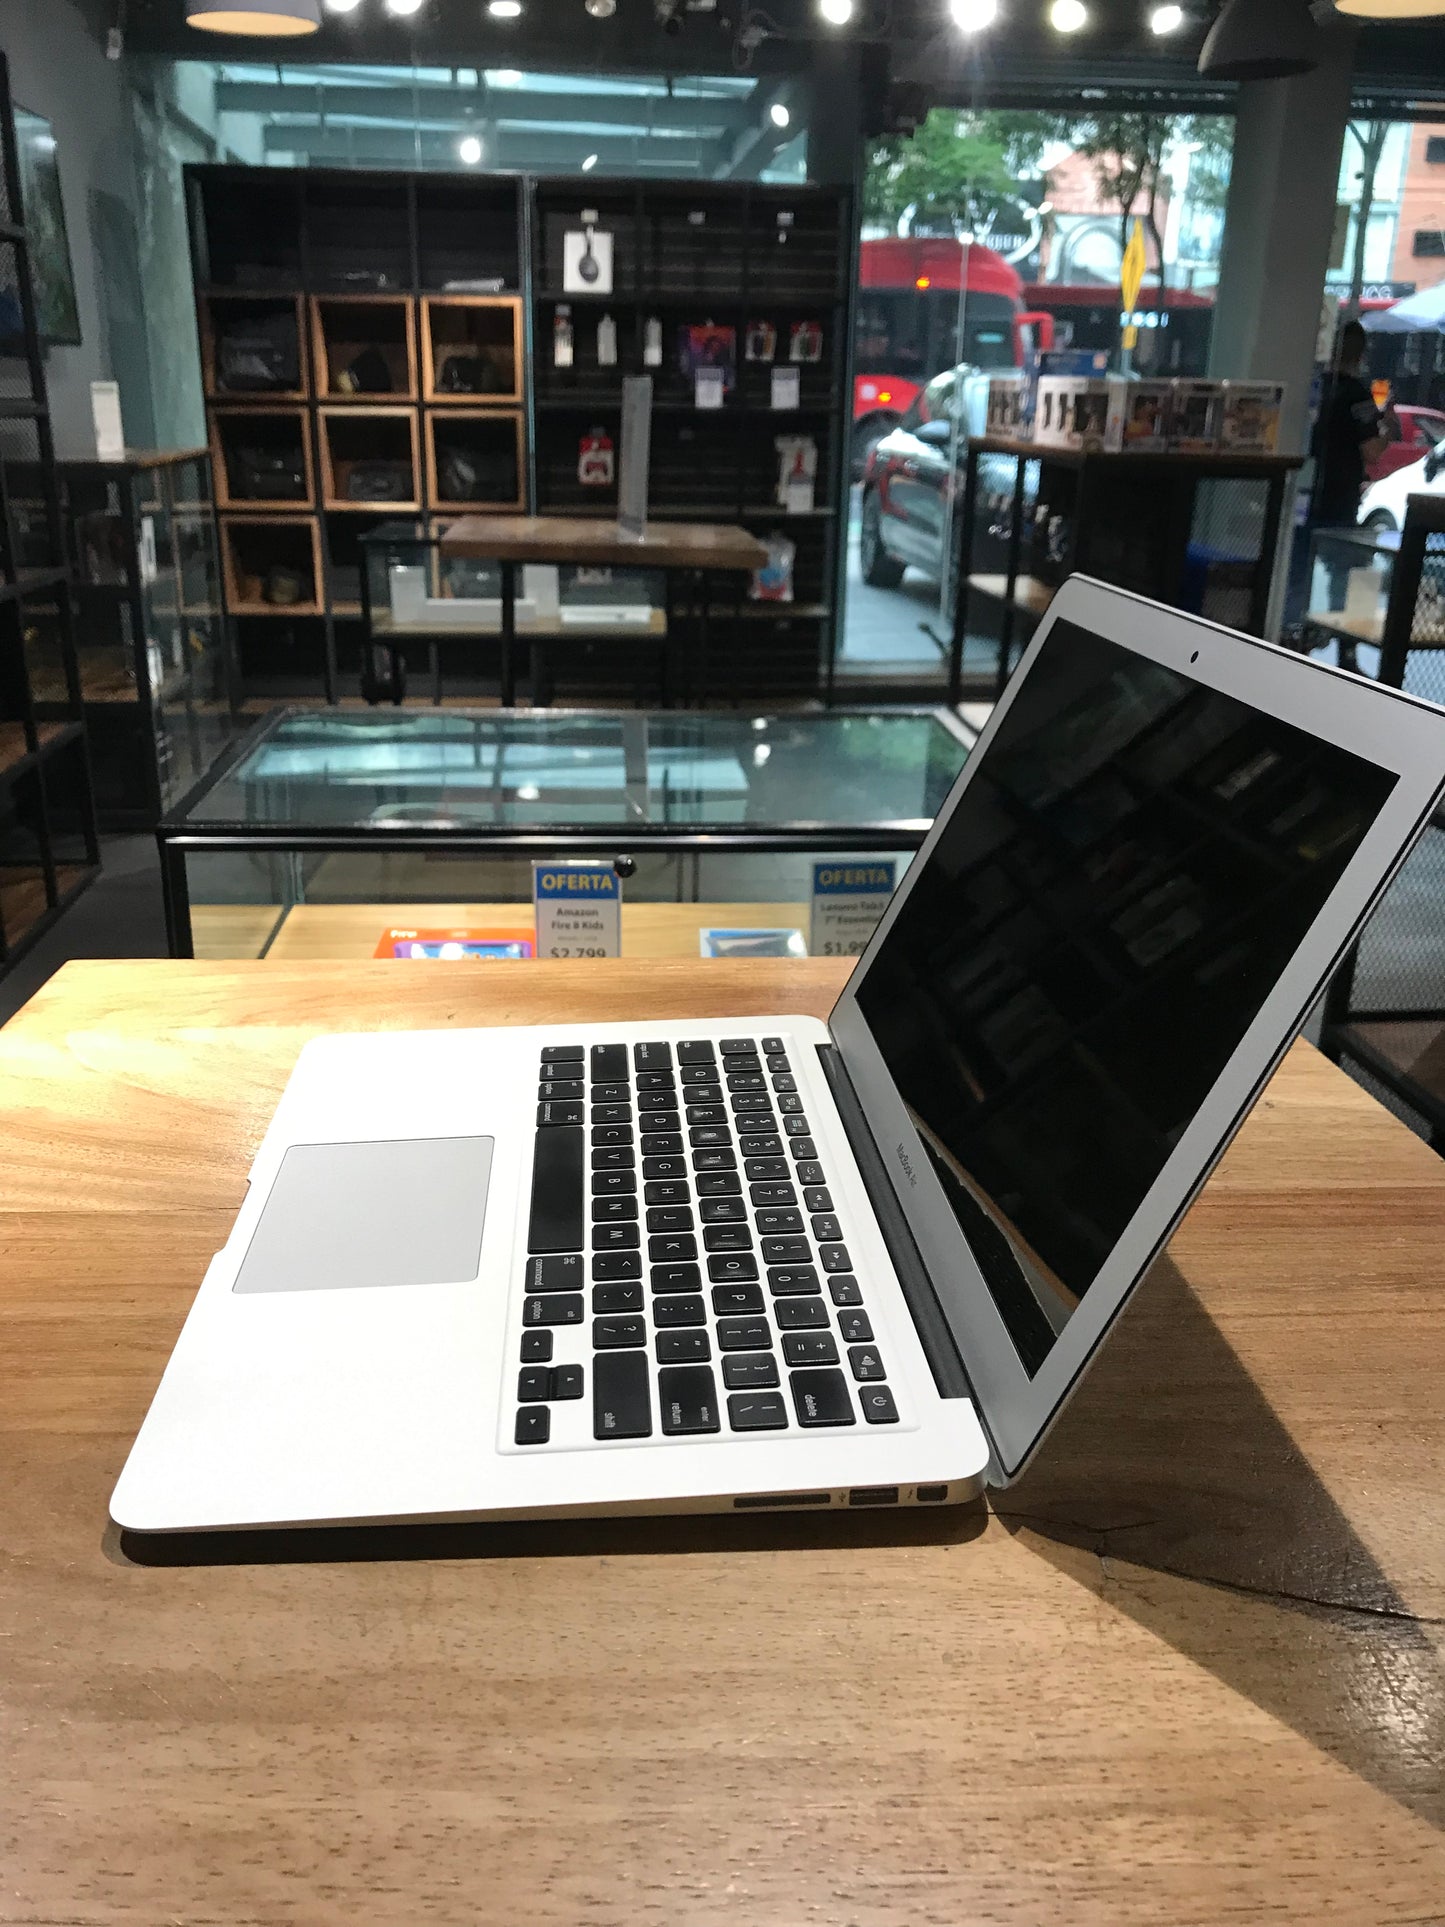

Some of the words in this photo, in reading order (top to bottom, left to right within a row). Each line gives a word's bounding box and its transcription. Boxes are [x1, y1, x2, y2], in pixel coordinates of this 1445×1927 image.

[542, 874, 613, 890] OFERTA
[819, 869, 888, 885] OFERTA
[556, 907, 598, 916] Amazon
[551, 920, 570, 930] Fire
[582, 920, 604, 930] Kids
[544, 1083, 553, 1094] option
[544, 1103, 552, 1121] command
[609, 1230, 623, 1238] M
[534, 1258, 544, 1285] command
[532, 1301, 542, 1319] option
[859, 1367, 868, 1375] F12
[672, 1402, 682, 1424] return
[805, 1394, 818, 1417] delete
[603, 1412, 615, 1428] shift
[701, 1406, 710, 1422] enter
